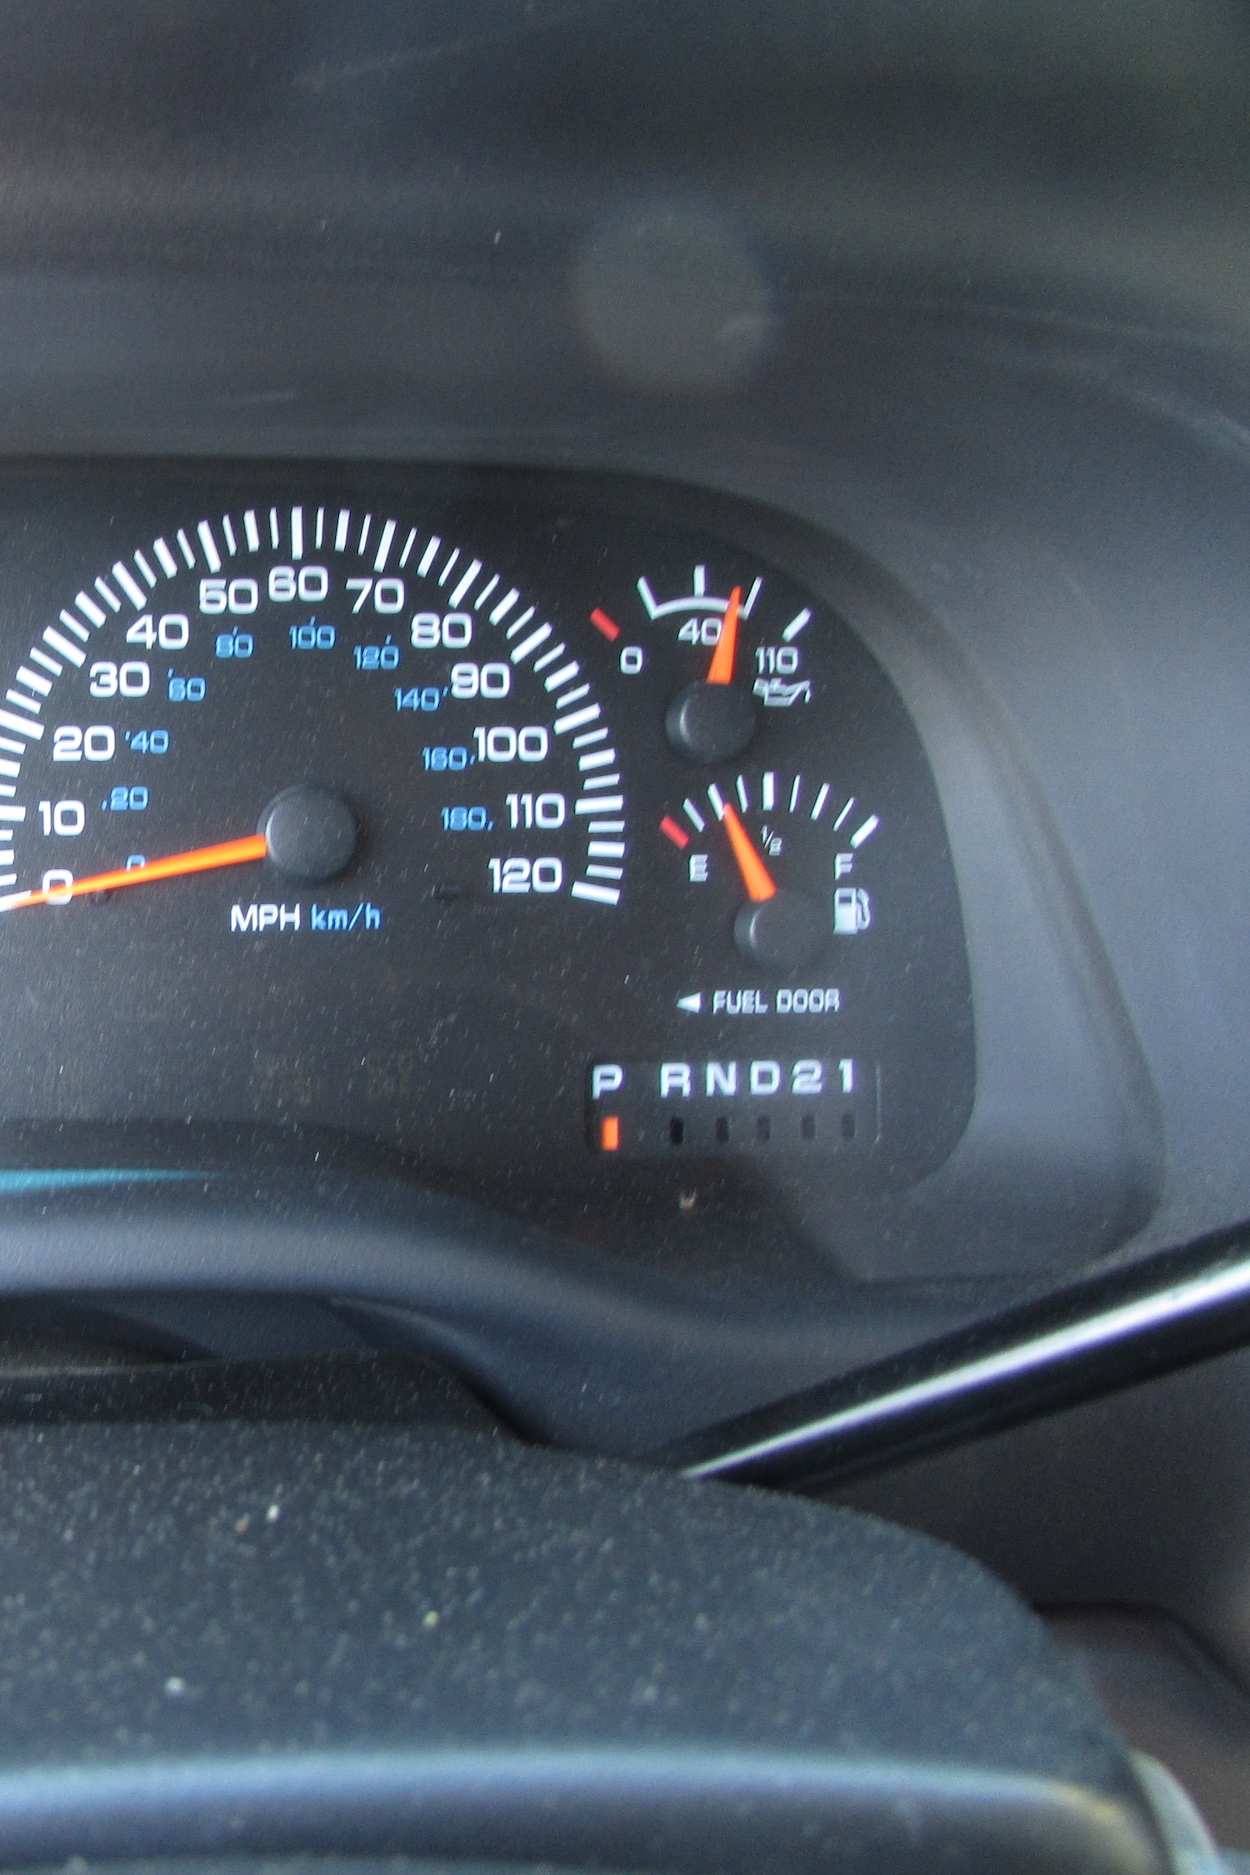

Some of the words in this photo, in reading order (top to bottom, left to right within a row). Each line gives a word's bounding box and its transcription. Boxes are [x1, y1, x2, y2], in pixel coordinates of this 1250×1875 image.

[199, 578, 258, 614] 50
[268, 565, 328, 602] 60
[346, 578, 405, 614] 70
[126, 614, 189, 649] 40
[289, 625, 336, 649] 100
[411, 613, 472, 649] 80
[678, 618, 722, 645] 40
[215, 634, 254, 658] 80
[353, 645, 399, 670] 120
[620, 646, 643, 674] 0
[755, 646, 798, 674] 110
[89, 661, 150, 697] 30
[168, 677, 206, 701] 60
[451, 662, 510, 699] 90
[394, 687, 440, 711] 140
[53, 725, 115, 761] 20
[130, 730, 170, 754] 40
[473, 726, 549, 762] 100
[422, 746, 468, 771] 160
[110, 786, 149, 811] 20
[506, 793, 565, 828] 110
[38, 800, 85, 836] 10
[441, 806, 486, 831] 180
[488, 857, 563, 893] 120
[689, 854, 708, 882] E
[834, 853, 854, 880] F
[42, 869, 73, 905] 0
[230, 903, 300, 932] MPH
[311, 902, 381, 931] km/h
[713, 990, 768, 1014] FUEL
[776, 988, 840, 1013] DOOR
[592, 1064, 623, 1100] P
[660, 1062, 691, 1098] R
[705, 1061, 737, 1096] N
[750, 1060, 781, 1095] D
[792, 1059, 822, 1094] 2
[839, 1059, 854, 1093] 1
